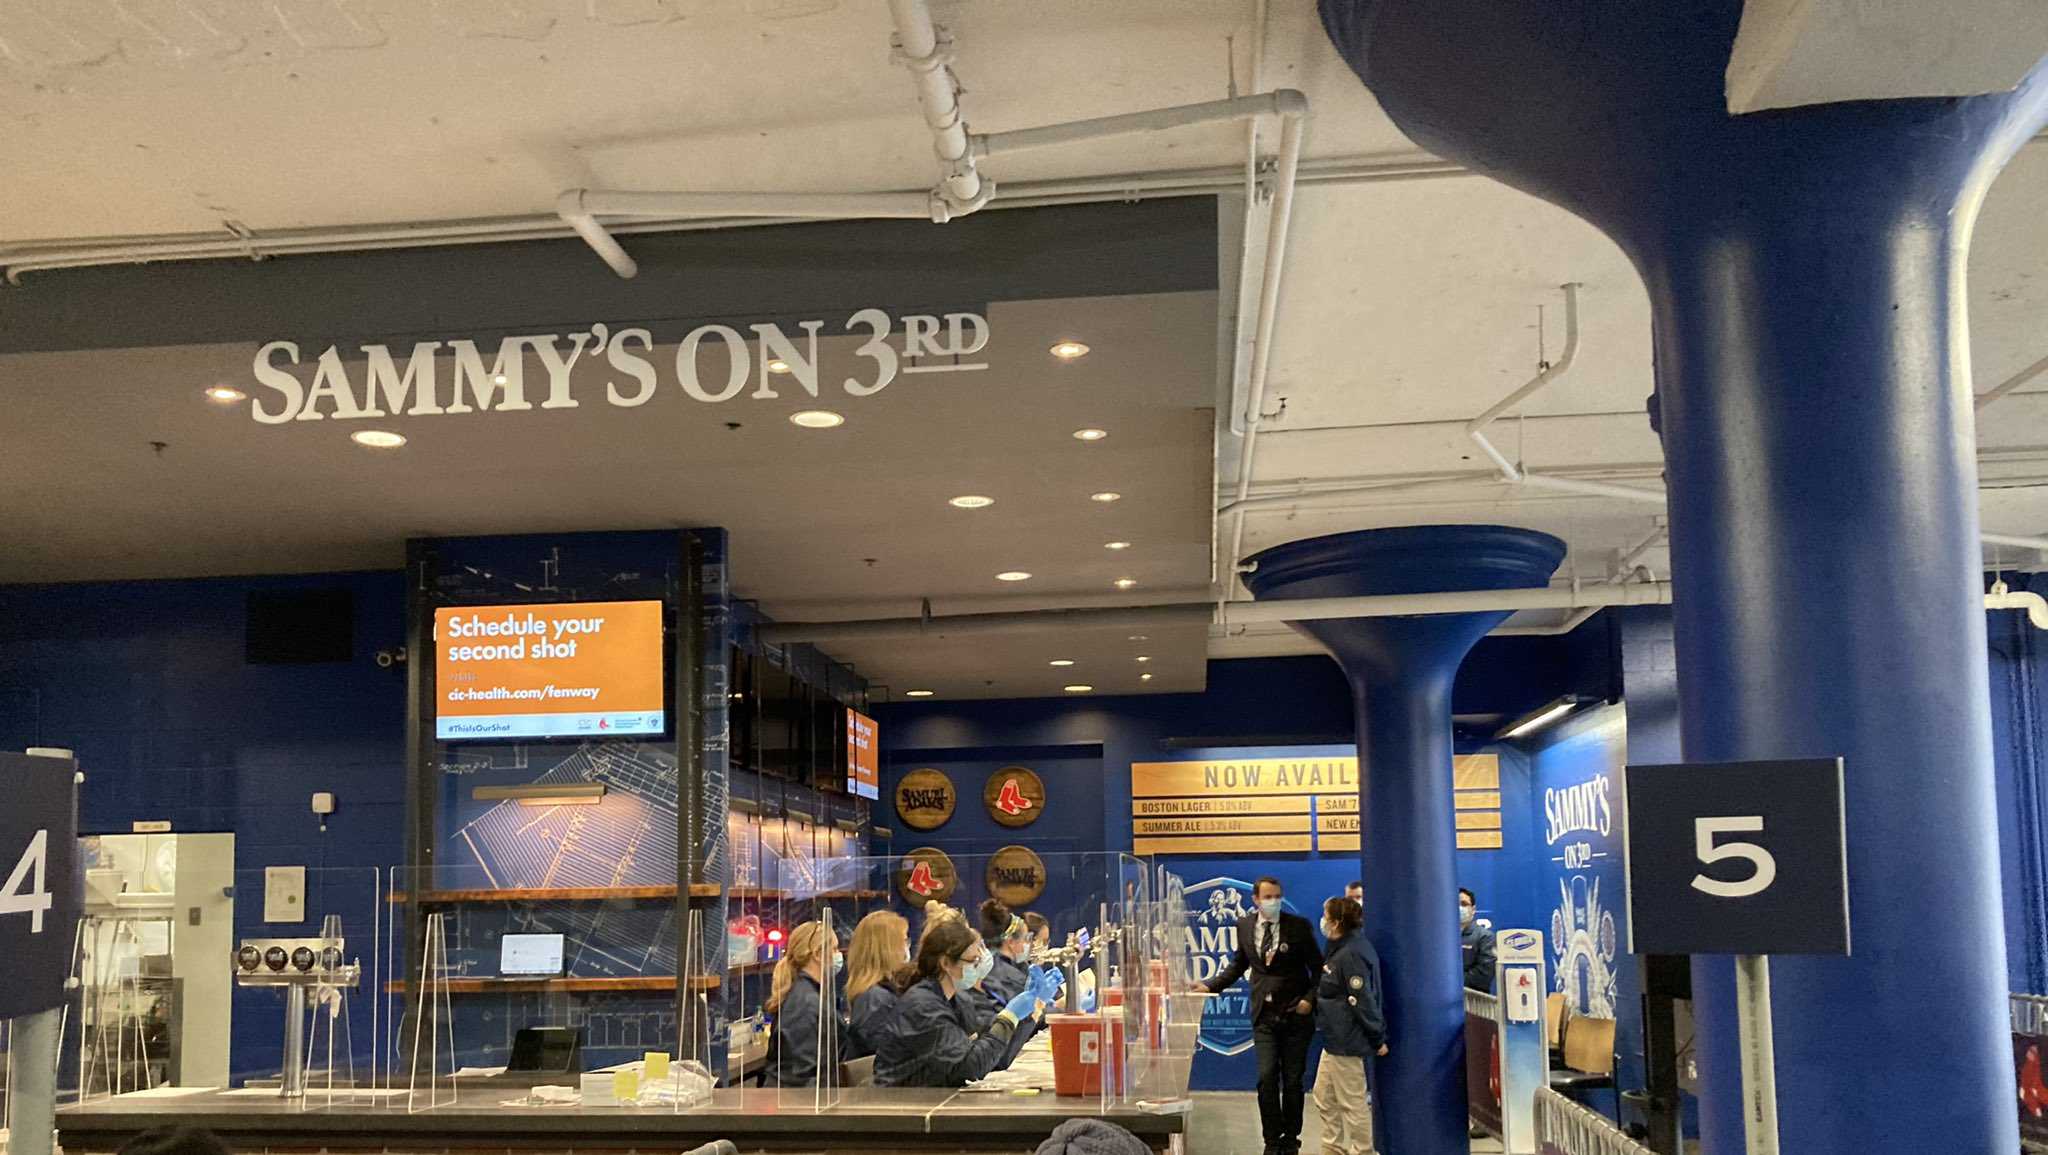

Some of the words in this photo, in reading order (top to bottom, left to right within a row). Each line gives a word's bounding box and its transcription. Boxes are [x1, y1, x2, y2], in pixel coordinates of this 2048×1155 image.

[252, 322, 658, 424] SAMMY'S
[675, 320, 825, 401] ON
[844, 308, 990, 398] 3RD
[448, 613, 547, 637] Schedule
[552, 618, 604, 640] your
[448, 637, 525, 661] second
[531, 636, 577, 658] shot
[448, 685, 600, 701] cic-health.com/fenway
[1205, 765, 1261, 788] NOW
[1275, 763, 1358, 787] AVAIL
[1142, 802, 1179, 813] BOSTON
[1181, 802, 1209, 812] LAGER
[1326, 799, 1347, 810] SAM
[1545, 774, 1610, 845] SAMMY'S
[1142, 821, 1182, 832] SUMMER
[1184, 821, 1200, 831] ALE
[1326, 819, 1347, 830] NEW
[1565, 845, 1577, 869] ON
[1690, 816, 1776, 897] 5
[0, 829, 52, 933] 4
[1203, 997, 1231, 1014] AM
[1233, 996, 1249, 1014] '7
